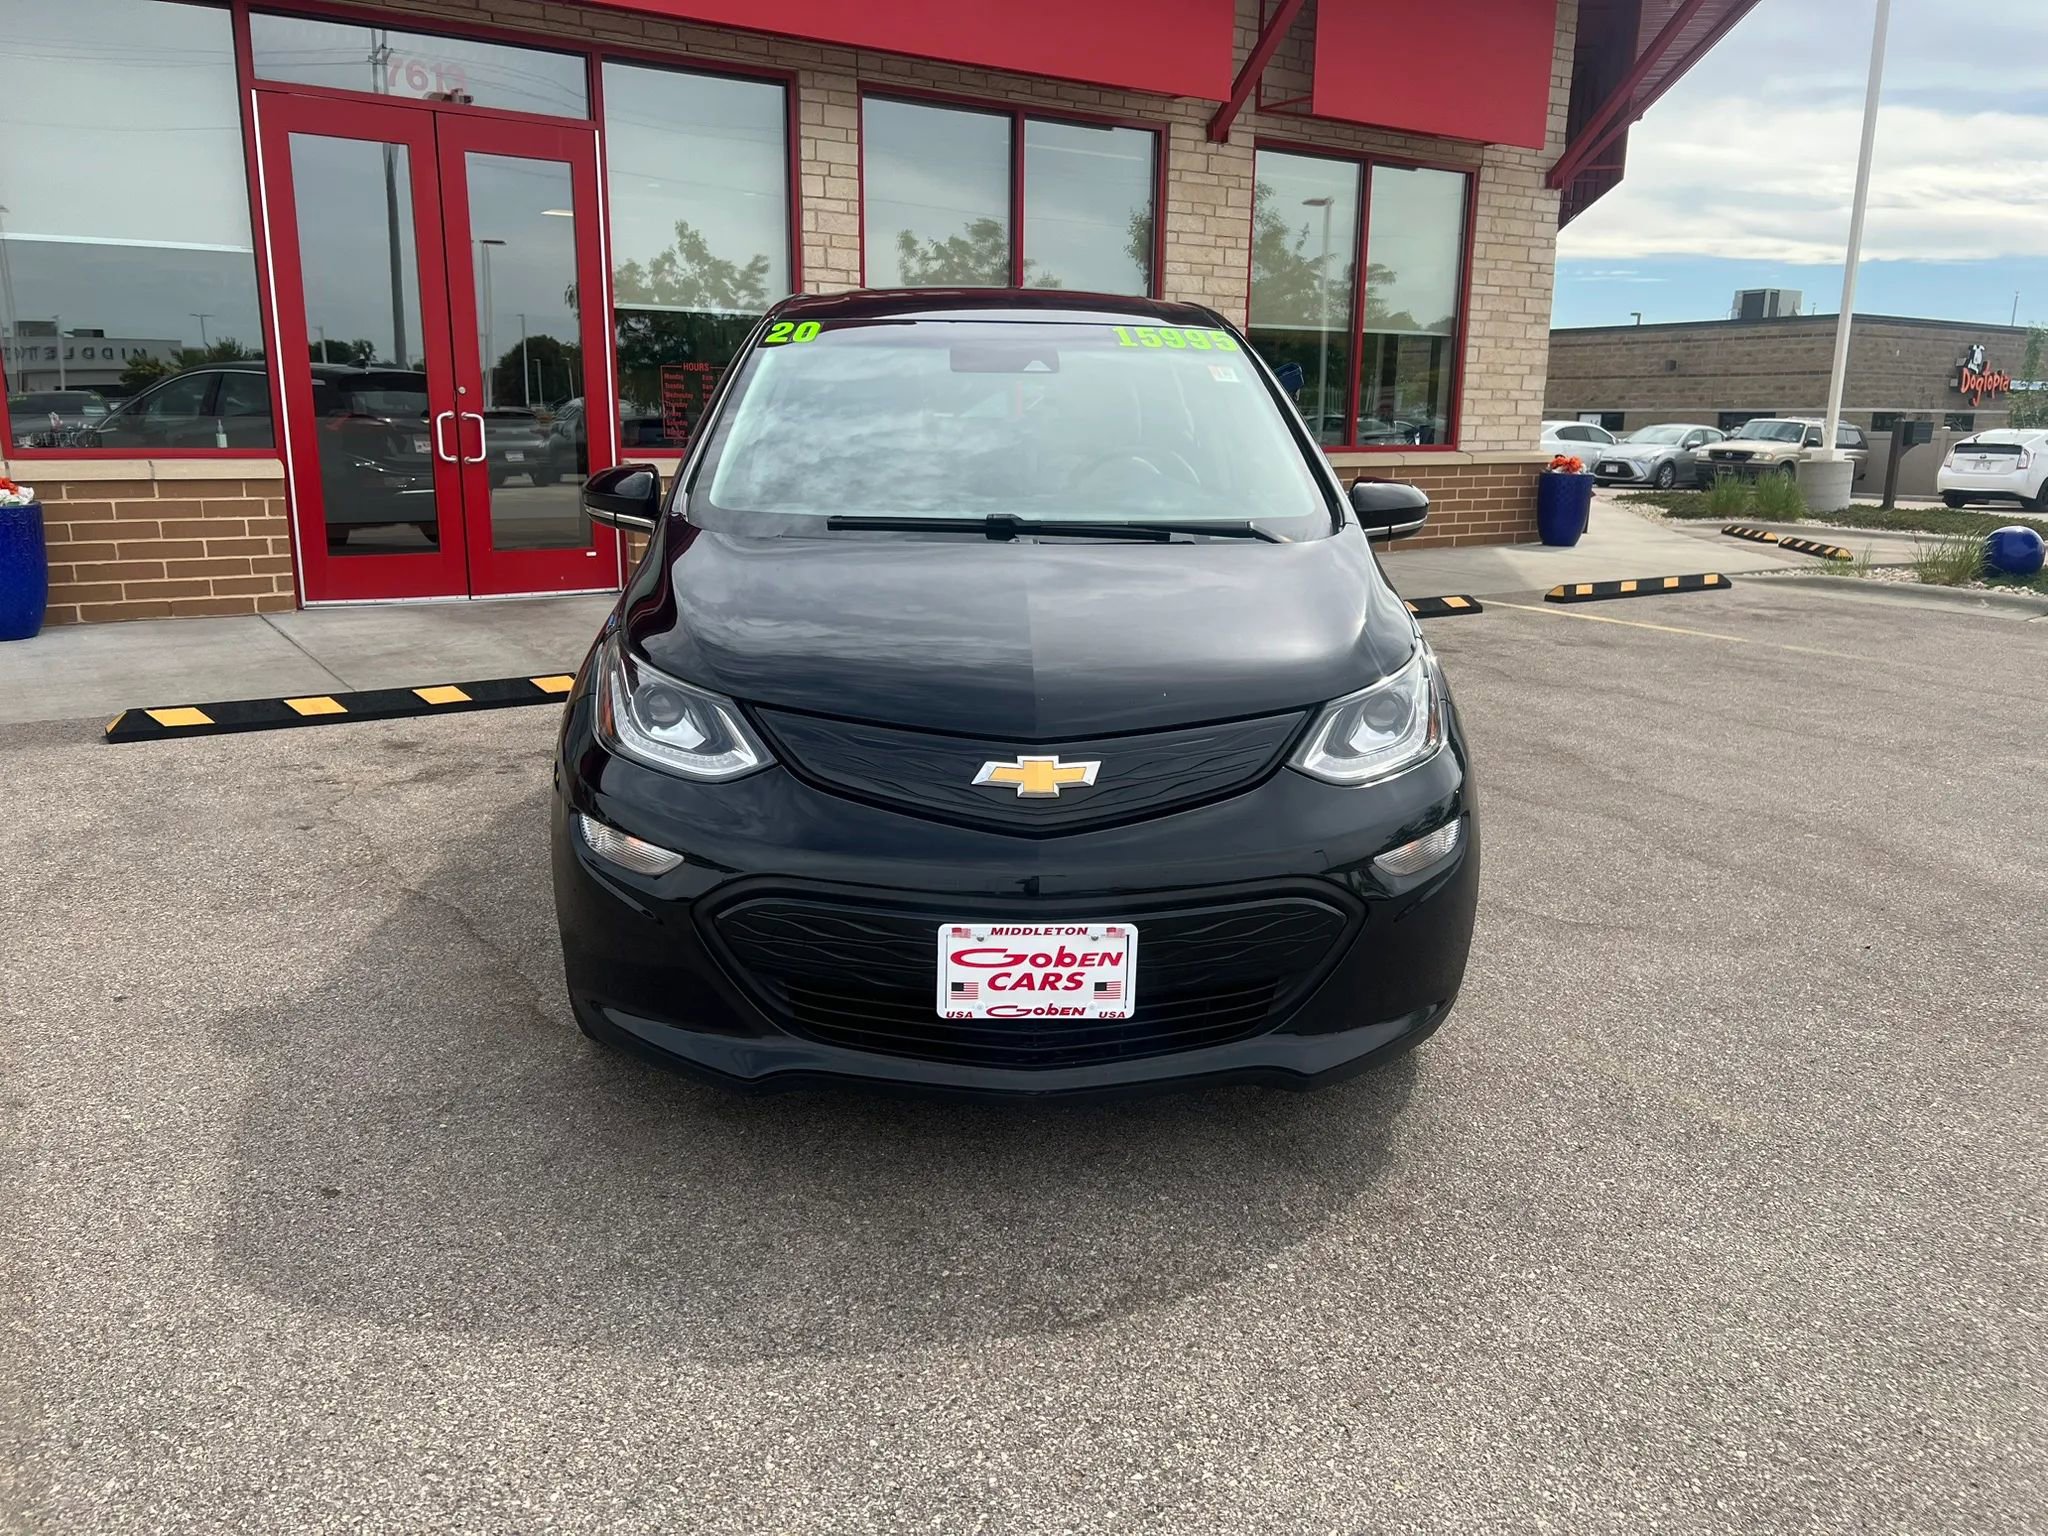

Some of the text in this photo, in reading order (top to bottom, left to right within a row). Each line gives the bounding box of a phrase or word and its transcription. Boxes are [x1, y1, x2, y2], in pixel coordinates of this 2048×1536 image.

[765, 321, 821, 343] 20
[1112, 326, 1239, 352] 15995
[683, 362, 710, 371] HOURS
[664, 373, 684, 381] Monday
[664, 383, 685, 391] Tuesday
[1960, 359, 2011, 408] Dogtopia
[664, 392, 694, 400] Wednesday
[665, 401, 688, 409] Thursday
[990, 927, 1088, 936] MIDDLETON
[987, 972, 1086, 991] CARS
[946, 1011, 973, 1019] USA
[1098, 1011, 1126, 1019] USA
